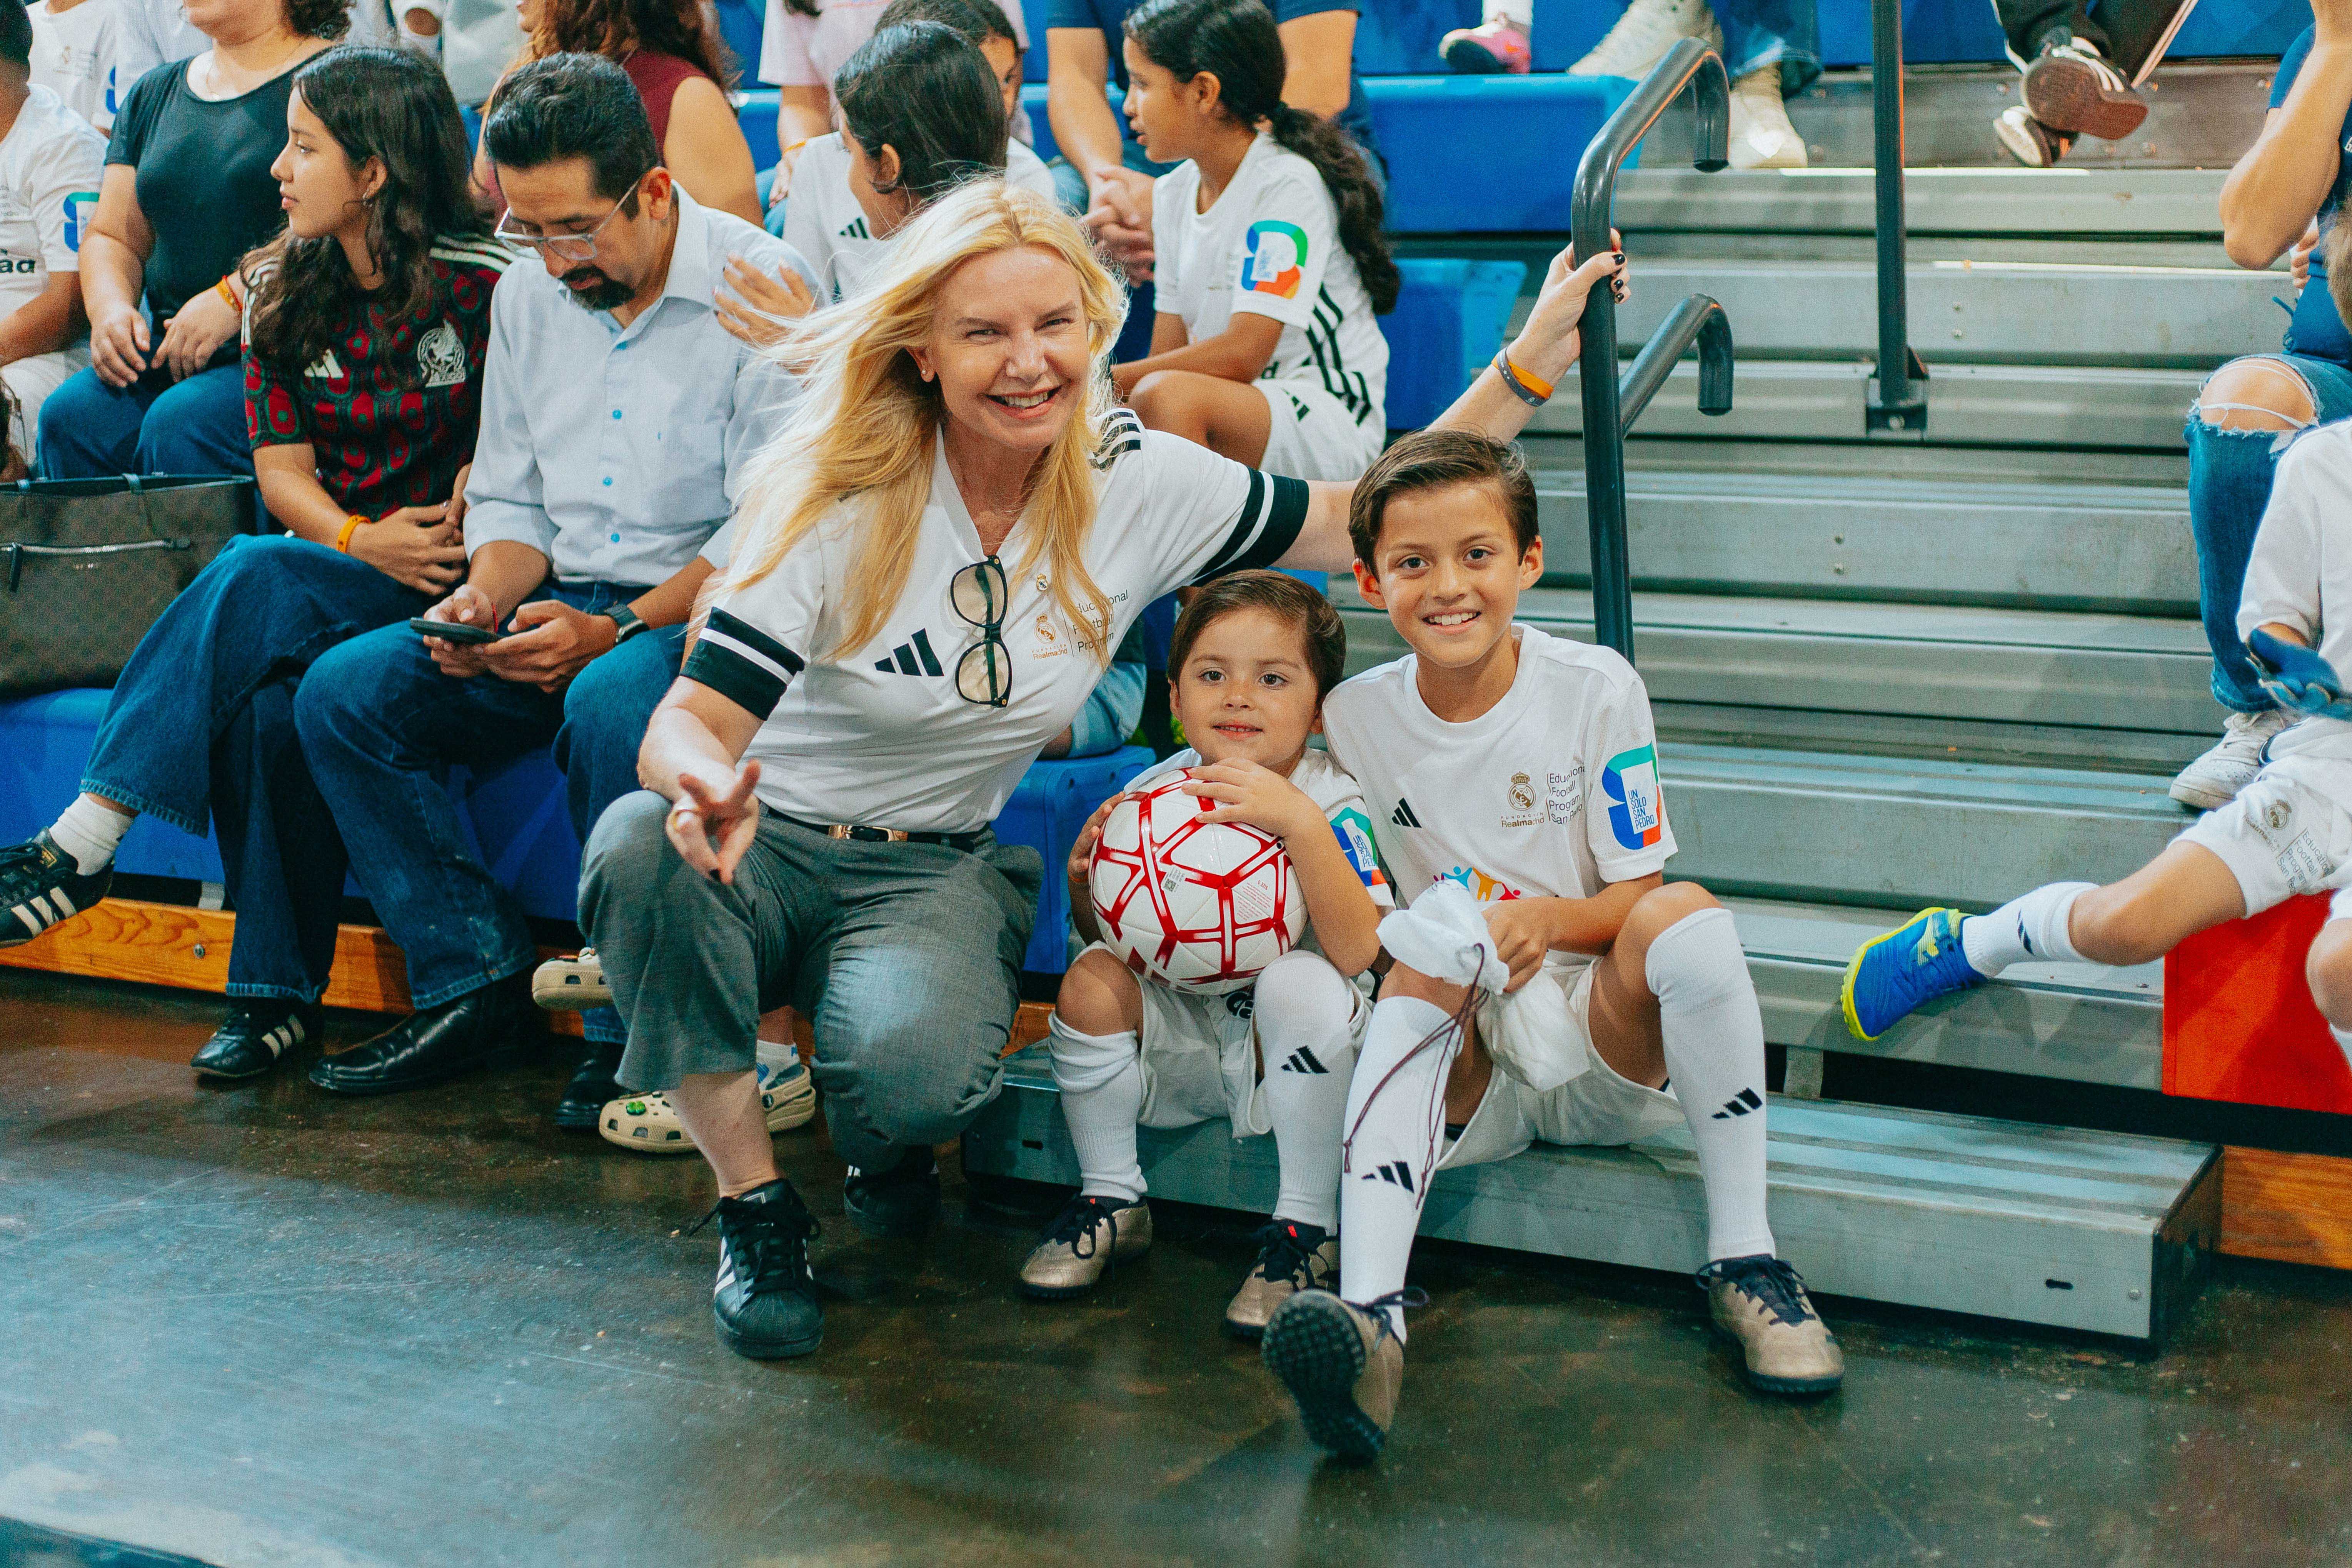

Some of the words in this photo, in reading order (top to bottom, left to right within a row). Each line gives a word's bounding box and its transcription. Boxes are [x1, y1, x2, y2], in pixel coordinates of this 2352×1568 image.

[1628, 788, 1638, 800] UN
[1630, 796, 1646, 809] SOLO
[1551, 813, 1568, 824] San
[1633, 807, 1646, 819] SAN
[1635, 814, 1655, 830] PEDRO
[2277, 857, 2289, 877] San
